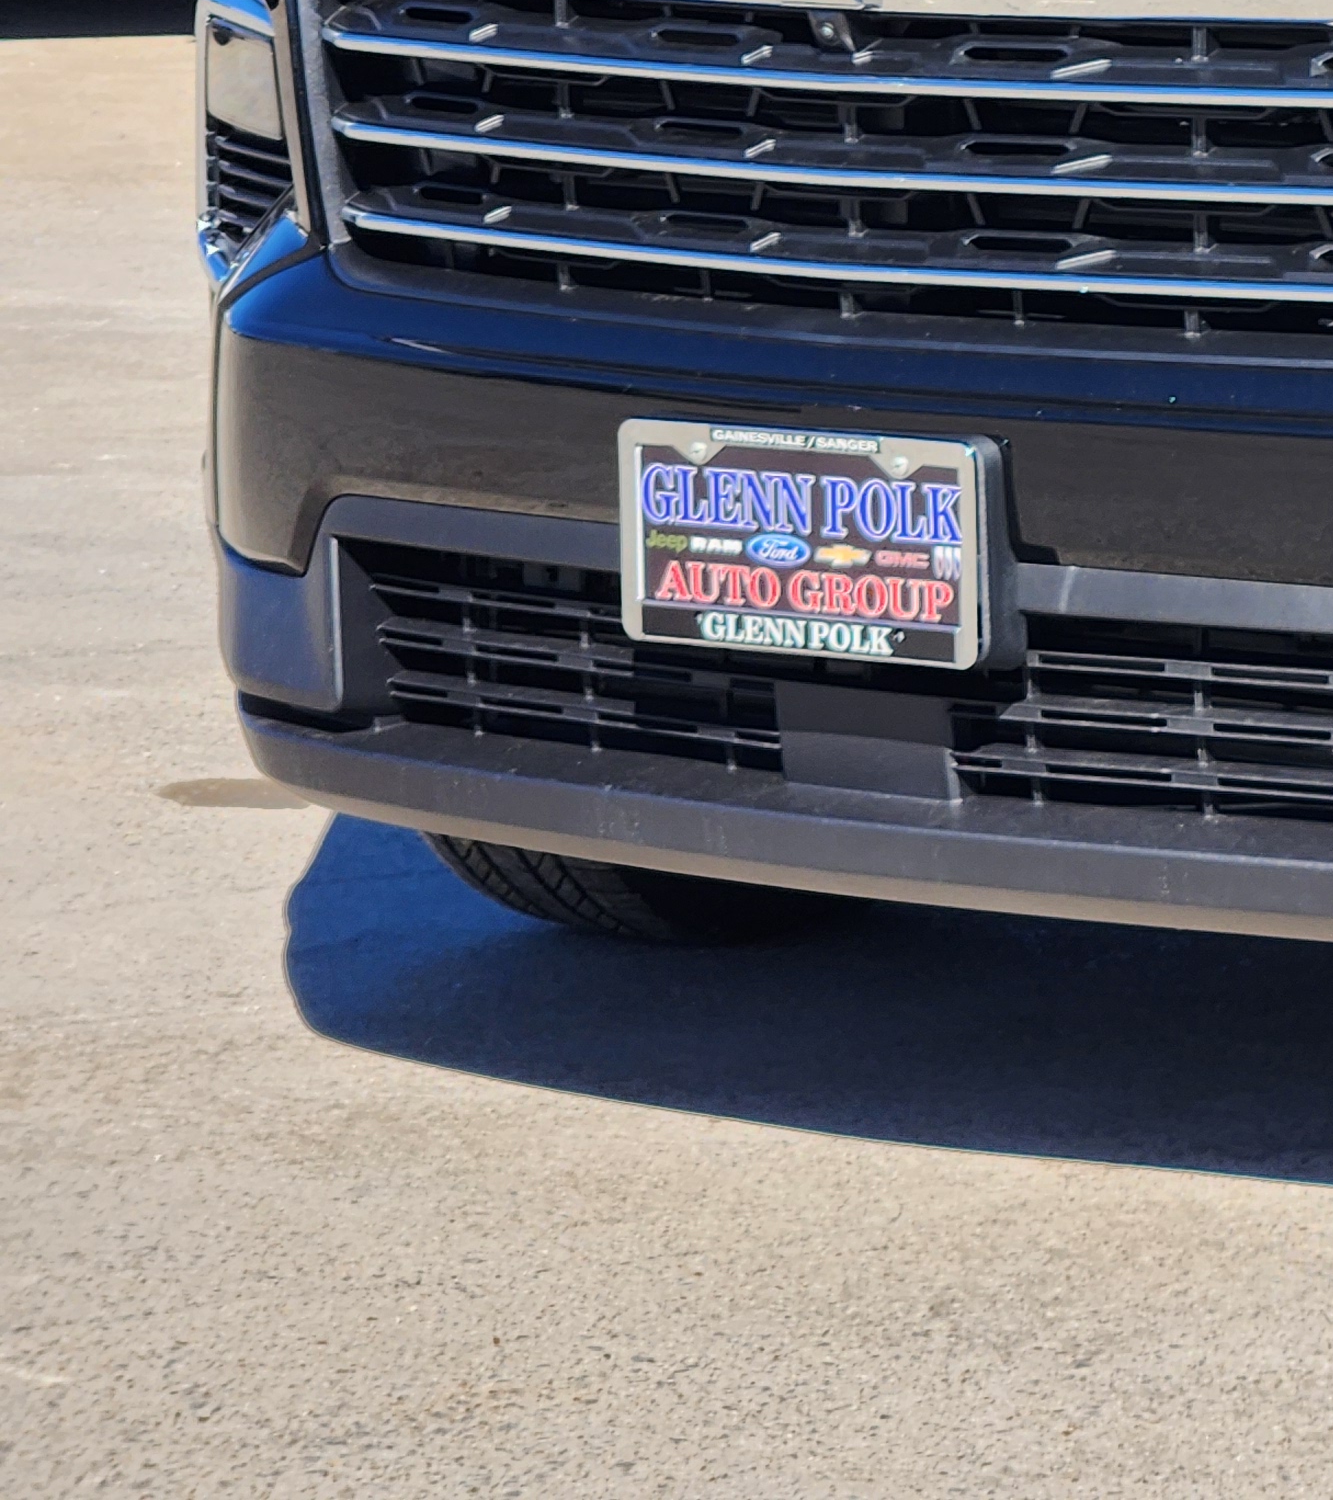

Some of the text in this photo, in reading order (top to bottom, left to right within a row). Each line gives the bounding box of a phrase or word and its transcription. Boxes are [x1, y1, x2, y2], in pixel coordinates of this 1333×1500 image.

[712, 428, 806, 447] GAINESVILLE
[817, 436, 879, 452] SANGER
[641, 462, 963, 544] GLENN POLK
[646, 529, 931, 569] Jeep RAM Ford GMC
[654, 559, 954, 622] AUTO GROUP
[701, 609, 895, 656] GLENN POLK
